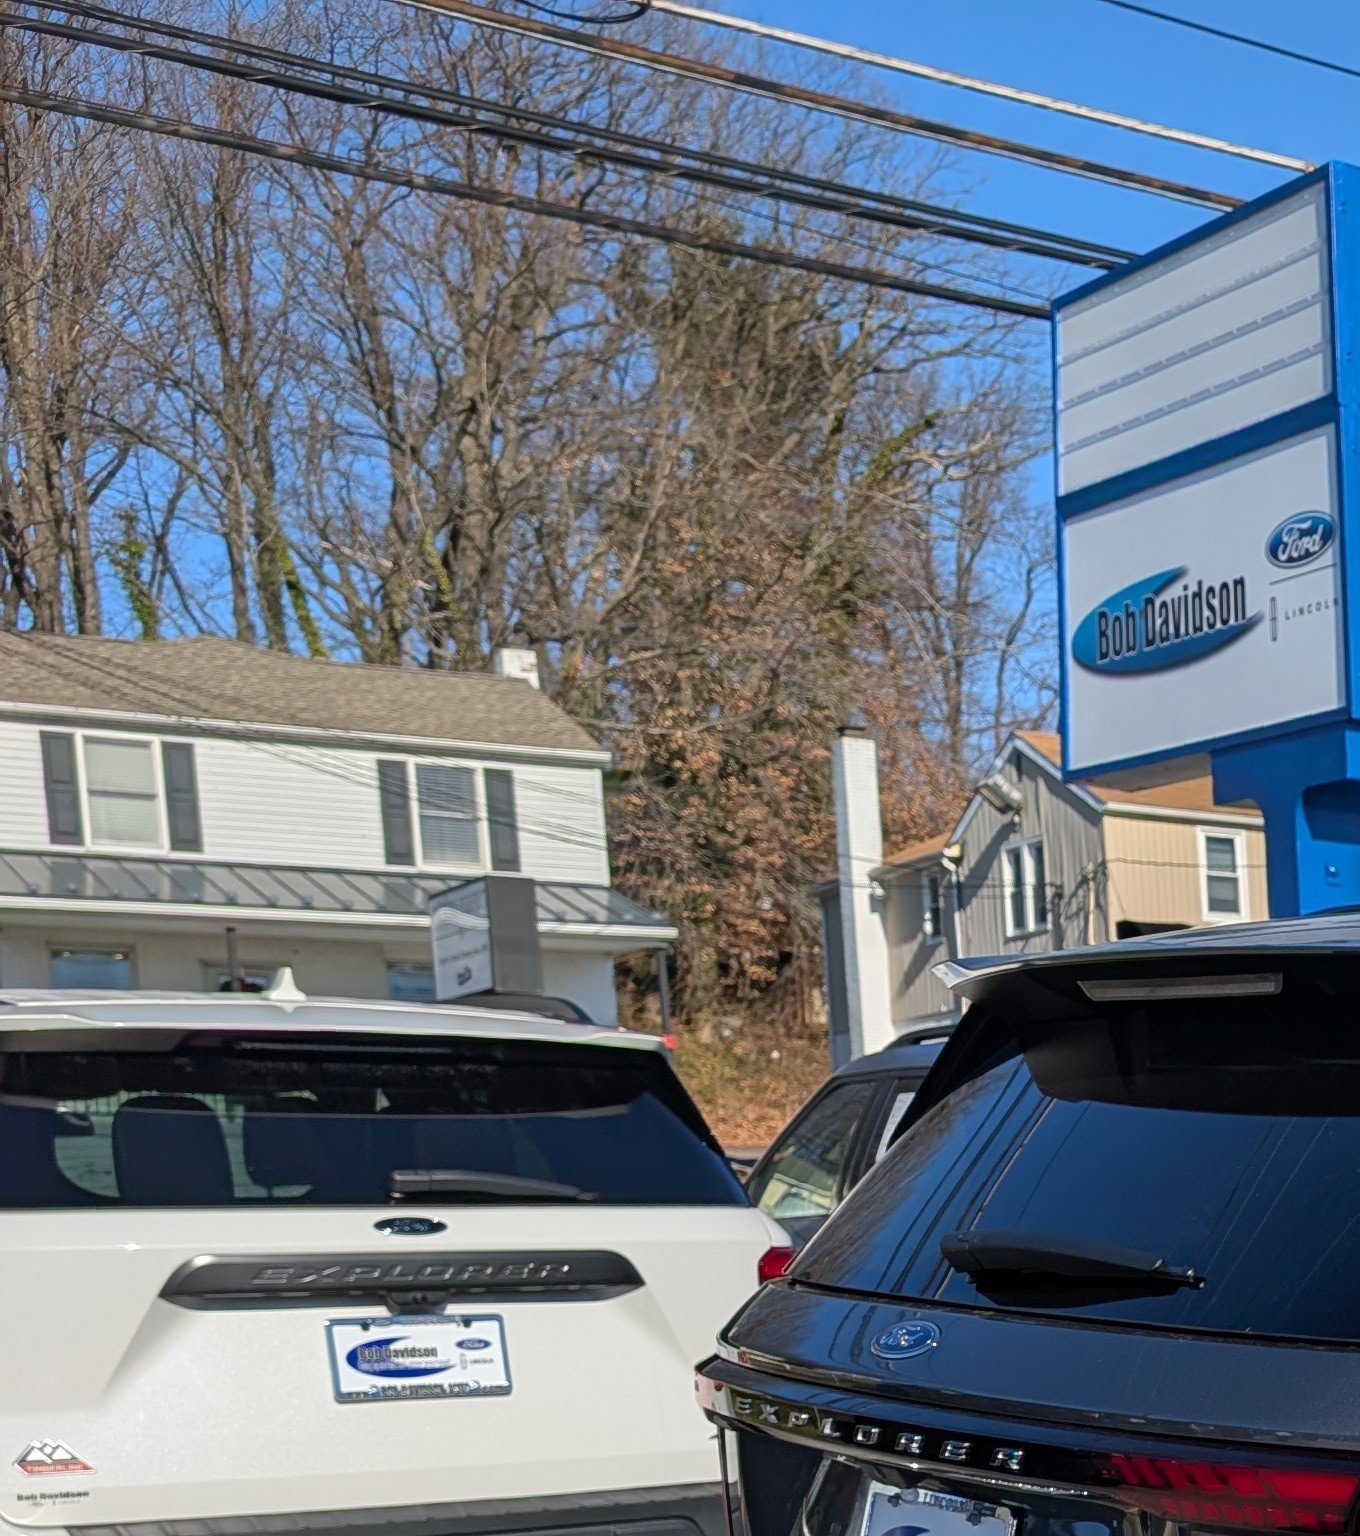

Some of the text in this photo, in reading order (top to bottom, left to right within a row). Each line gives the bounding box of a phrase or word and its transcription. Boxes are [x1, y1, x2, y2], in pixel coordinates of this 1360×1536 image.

[1277, 519, 1326, 562] Ford
[1097, 575, 1249, 664] Bob Davidson
[252, 1264, 571, 1284] EXPLORER
[385, 1345, 438, 1359] Davidson
[879, 1324, 925, 1347] Ford
[734, 1396, 1027, 1472] EXPLORER
